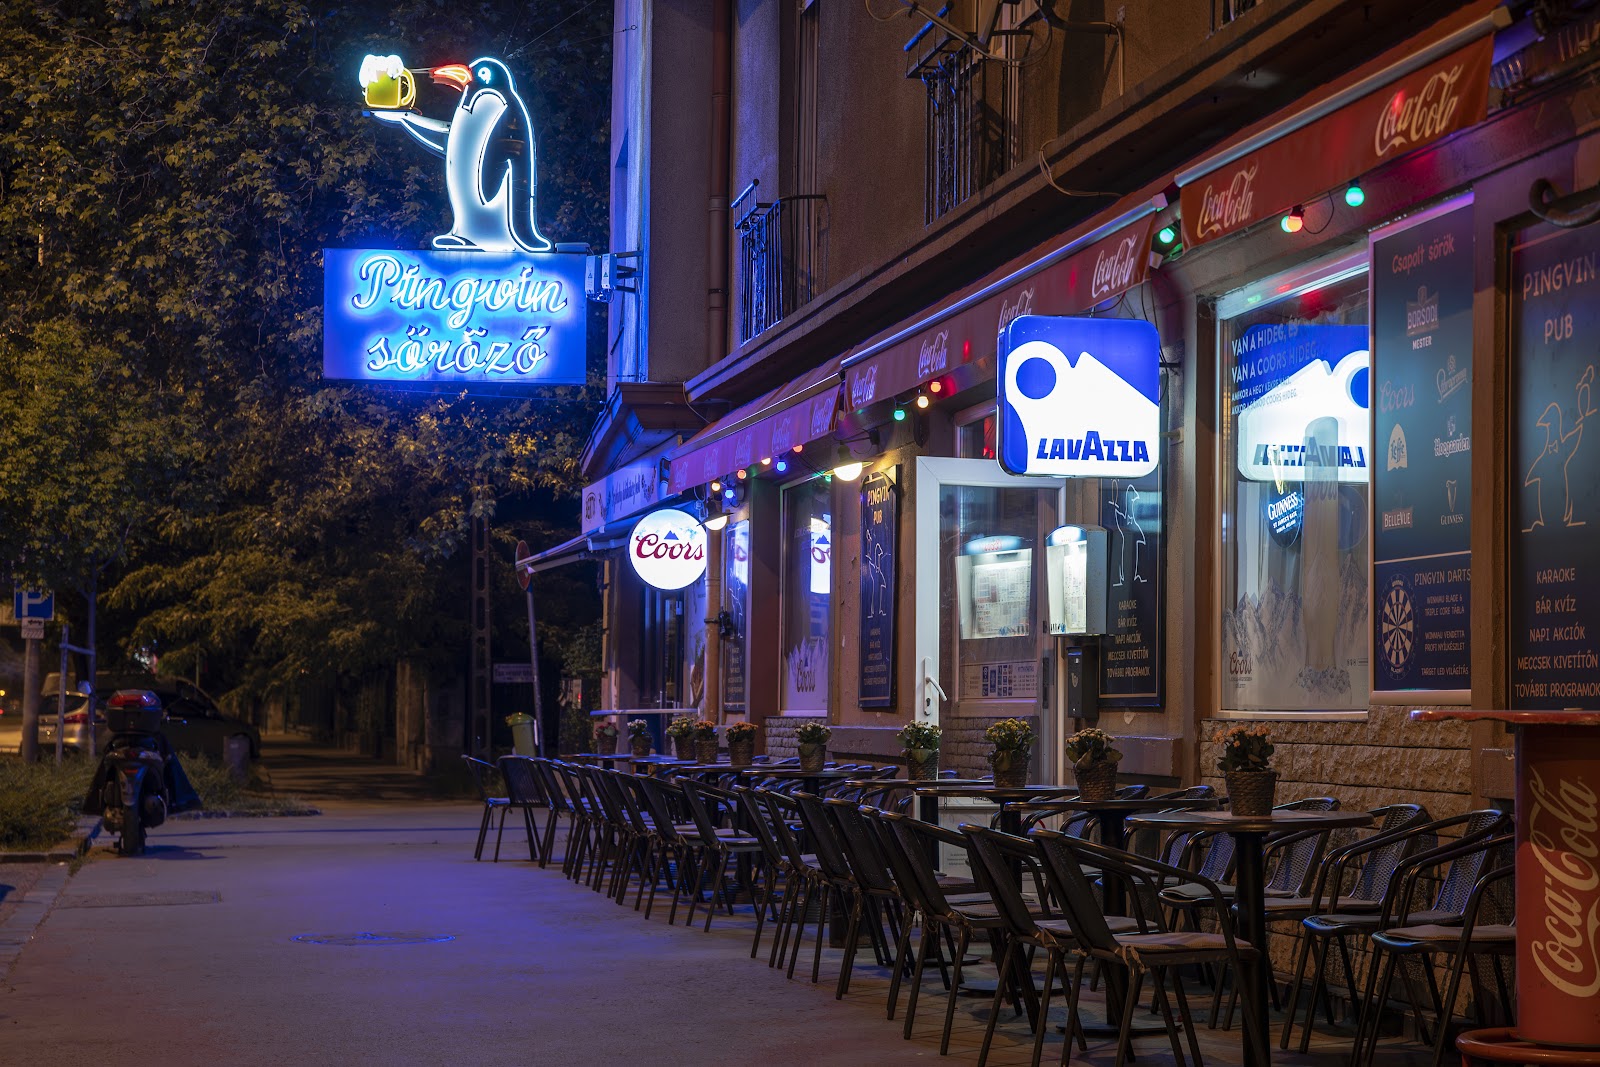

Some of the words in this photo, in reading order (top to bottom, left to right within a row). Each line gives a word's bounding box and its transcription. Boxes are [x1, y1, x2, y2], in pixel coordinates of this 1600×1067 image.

[1392, 243, 1426, 275] Csapolt
[1428, 233, 1456, 262] sörök
[1523, 251, 1596, 301] PINGVIN
[352, 255, 568, 329] Pingvin
[1407, 303, 1438, 330] BORSODI
[1544, 312, 1573, 345] PUB
[1231, 335, 1249, 357] VAN
[1250, 333, 1256, 352] A
[1257, 323, 1287, 348] HIDEG,
[1412, 335, 1432, 351] MESTER
[1231, 361, 1249, 384] VAN
[1250, 361, 1256, 378] A
[1257, 351, 1287, 376] COORS
[1380, 380, 1415, 414] Coors
[1036, 430, 1150, 462] LAVAZZA
[1434, 433, 1470, 458] Hoegaarden
[873, 509, 883, 525] PUB
[1268, 491, 1298, 521] GUINNESS
[635, 533, 705, 561] Coors
[1414, 570, 1445, 587] PINGVIN
[1447, 568, 1471, 583] DARTS
[1536, 567, 1576, 584] KARAOKE
[22, 588, 47, 616] P
[1535, 595, 1552, 614] BÁR
[1554, 594, 1577, 613] KVÍZ
[1529, 628, 1550, 643] NAPI
[1553, 621, 1586, 641] AKCIÓK
[1229, 651, 1253, 675] Coors
[1517, 656, 1551, 671] MECCSEK
[1553, 649, 1599, 669] KIVETÍTŐN
[1515, 678, 1548, 698] TOVÁBBI
[1550, 682, 1600, 697] PROGRAMOK
